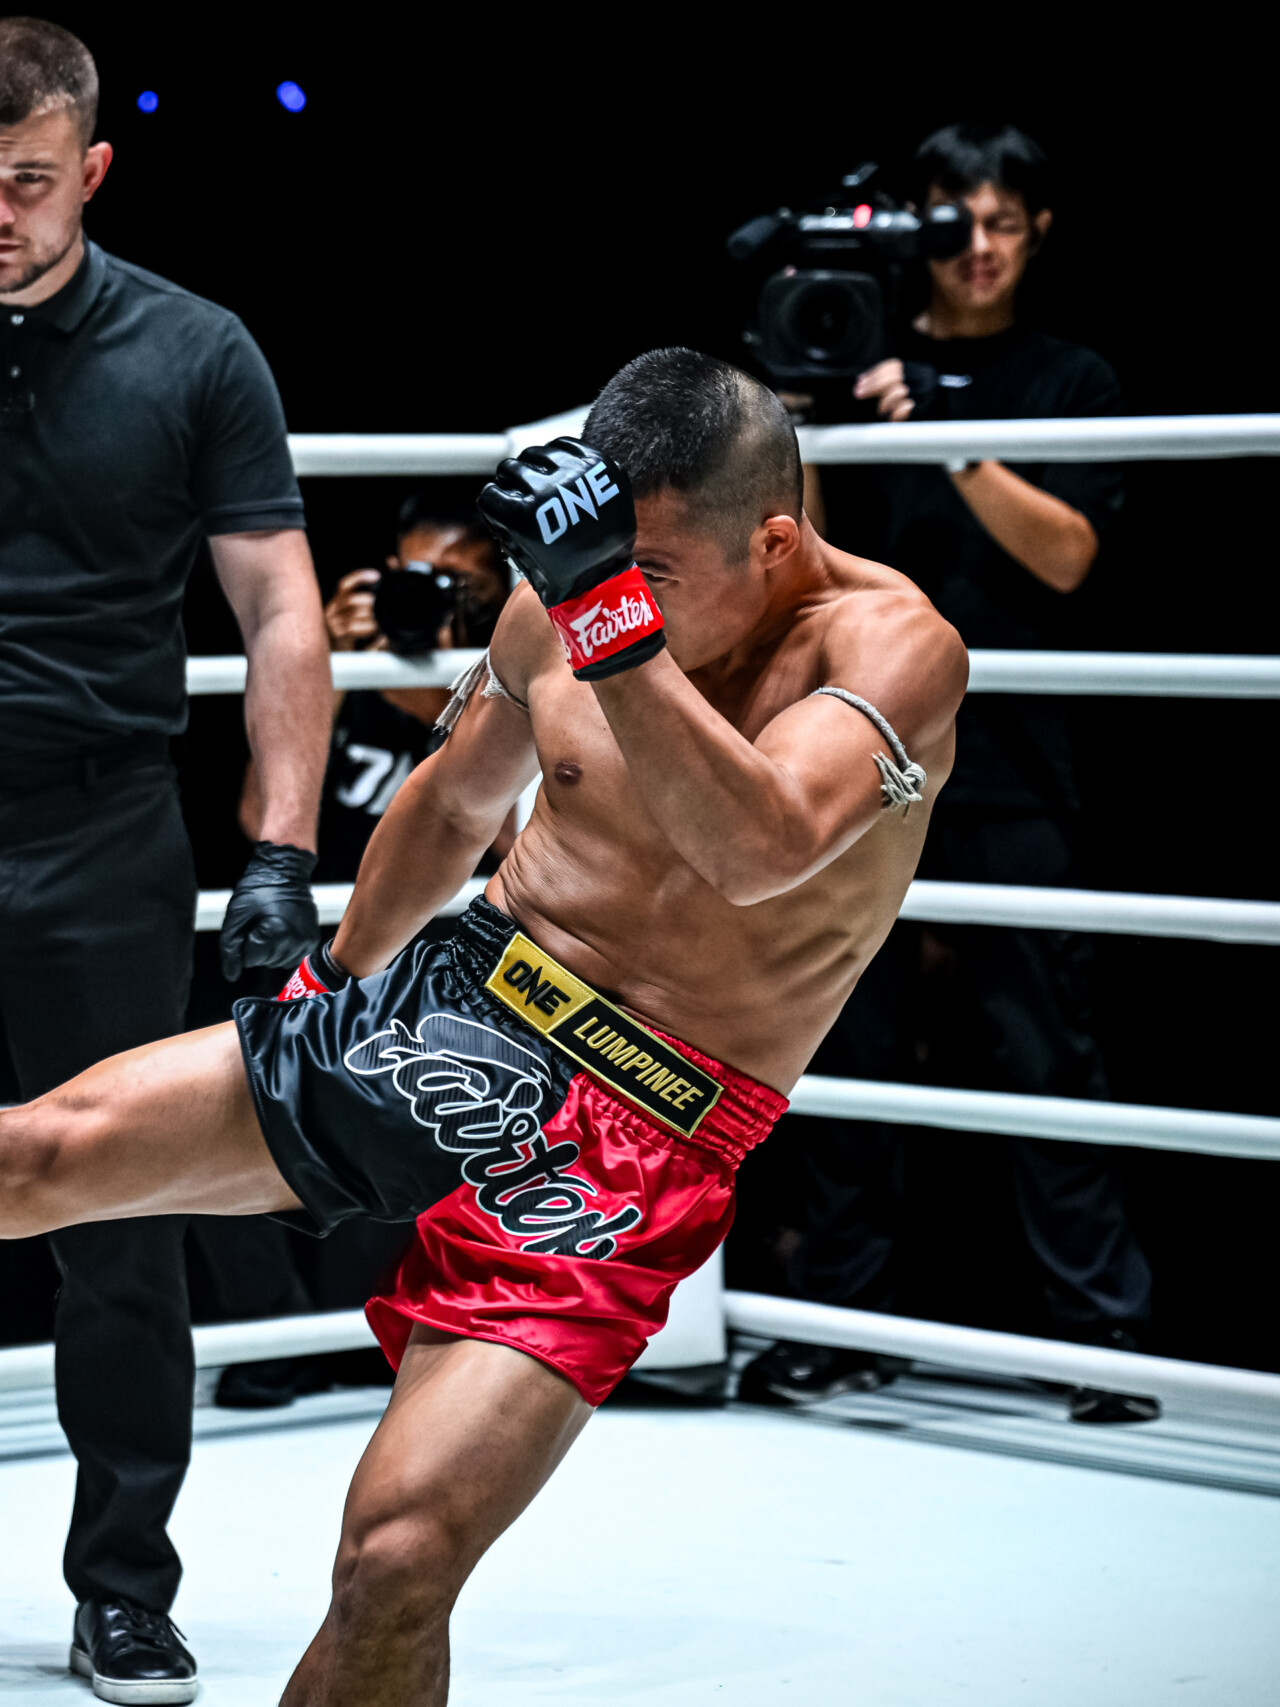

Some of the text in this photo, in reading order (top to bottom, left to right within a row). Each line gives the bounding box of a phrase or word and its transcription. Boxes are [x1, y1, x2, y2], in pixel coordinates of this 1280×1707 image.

[536, 461, 620, 545] ONE
[569, 591, 654, 658] Fairtex
[502, 959, 704, 1111] ONE LUMPINEE
[344, 1013, 642, 1261] Fairtex
